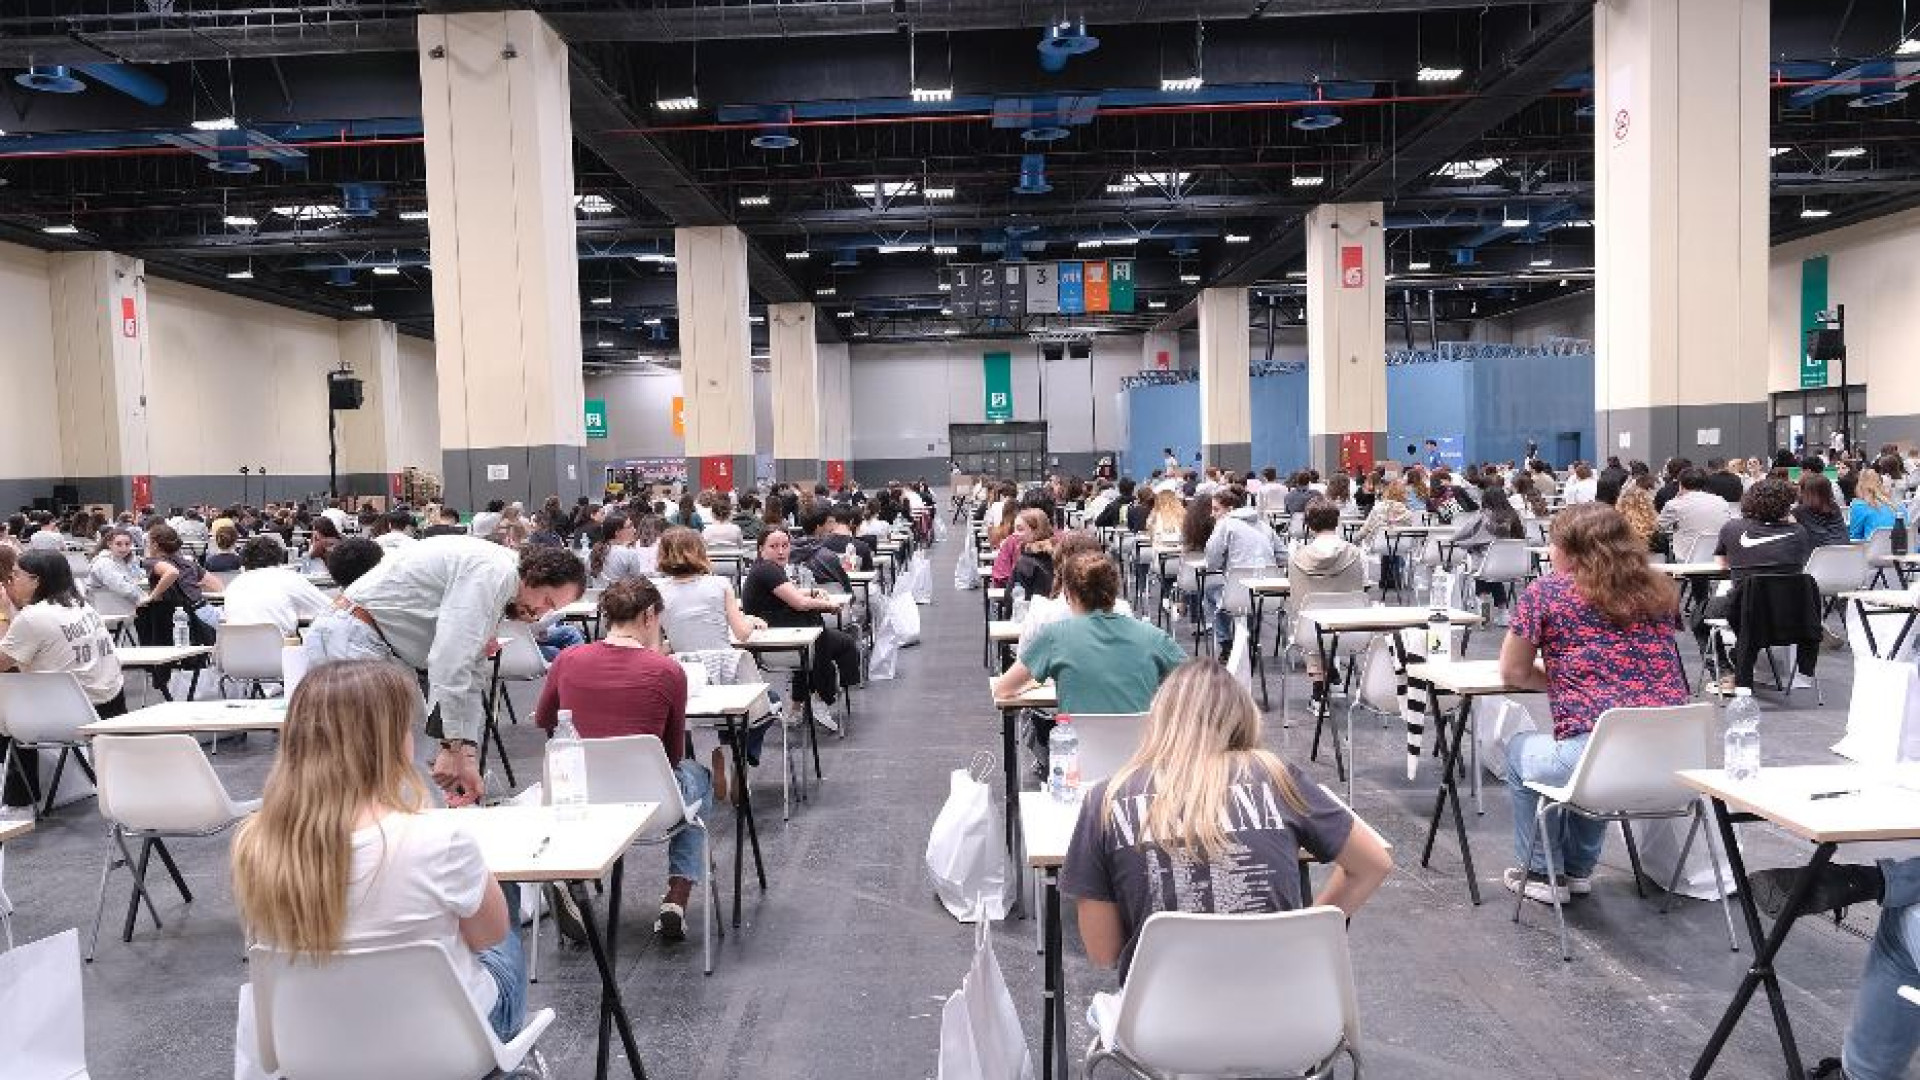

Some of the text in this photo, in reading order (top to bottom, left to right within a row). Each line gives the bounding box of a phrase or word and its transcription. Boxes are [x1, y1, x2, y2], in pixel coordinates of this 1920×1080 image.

[956, 268, 968, 287] 1
[981, 268, 995, 285] 2
[1036, 268, 1046, 285] 3
[1110, 780, 1286, 849] NINA
